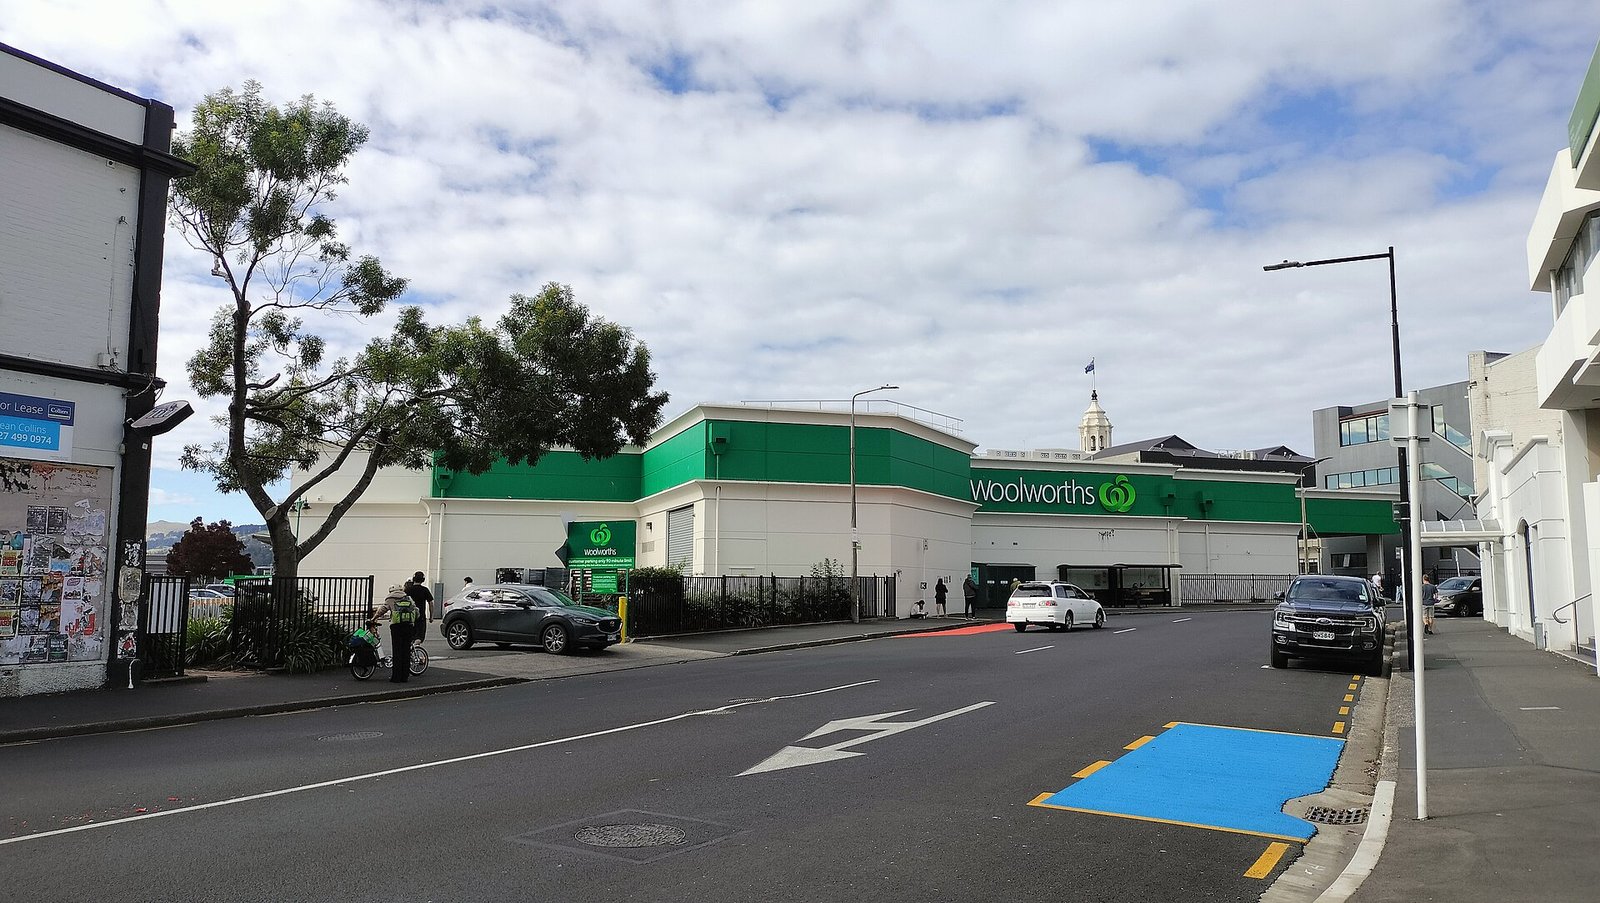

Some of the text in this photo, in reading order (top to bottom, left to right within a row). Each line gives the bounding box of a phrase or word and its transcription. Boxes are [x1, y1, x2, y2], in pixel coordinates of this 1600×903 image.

[0, 402, 43, 414] or Lease
[0, 422, 47, 435] ean Collins
[0, 431, 52, 445] 27 499 0974
[970, 477, 1095, 505] Woolworths
